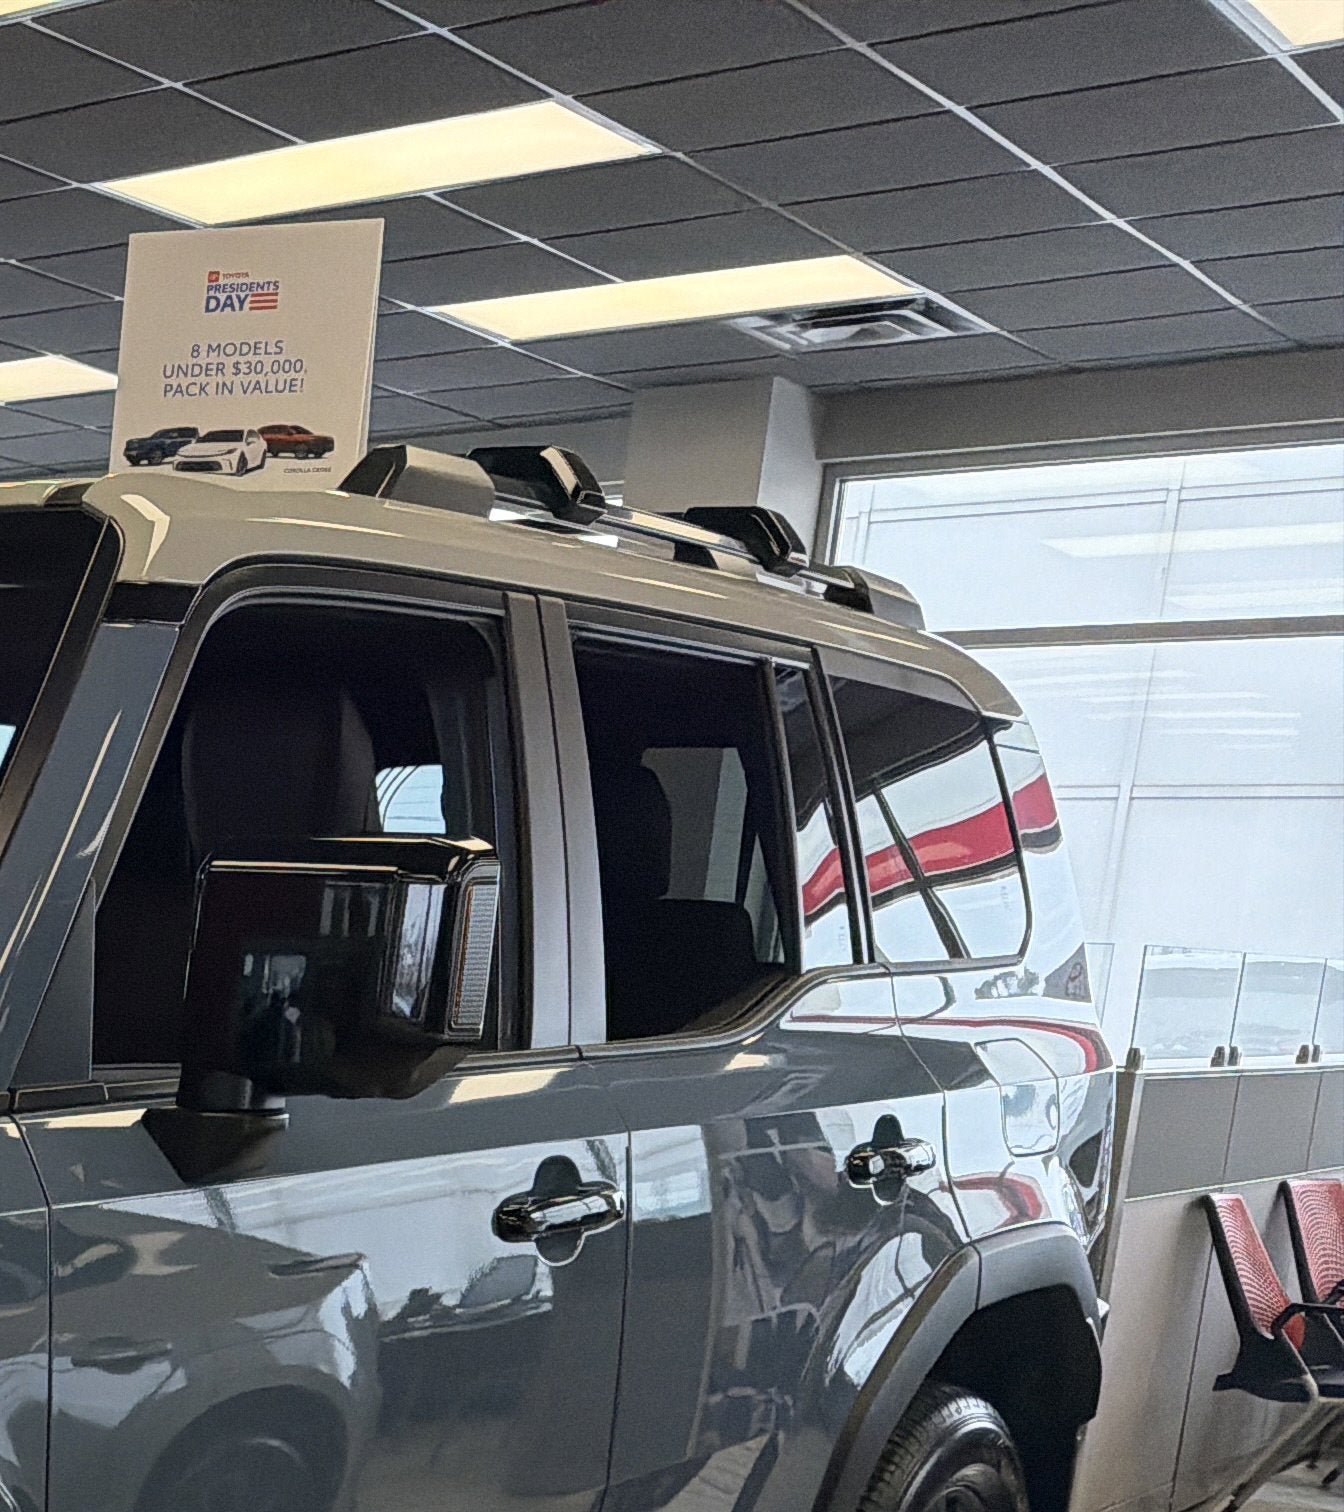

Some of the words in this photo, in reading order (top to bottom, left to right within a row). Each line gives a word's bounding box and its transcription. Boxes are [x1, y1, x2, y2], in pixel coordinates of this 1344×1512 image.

[207, 280, 280, 294] PRESIDENTS
[205, 294, 250, 313] DAY
[191, 343, 201, 359] 8
[206, 340, 285, 358] MODELS
[162, 362, 226, 379] UNDER
[163, 381, 210, 398] PACK
[215, 380, 235, 395] IN
[240, 378, 305, 395] VALUE!
